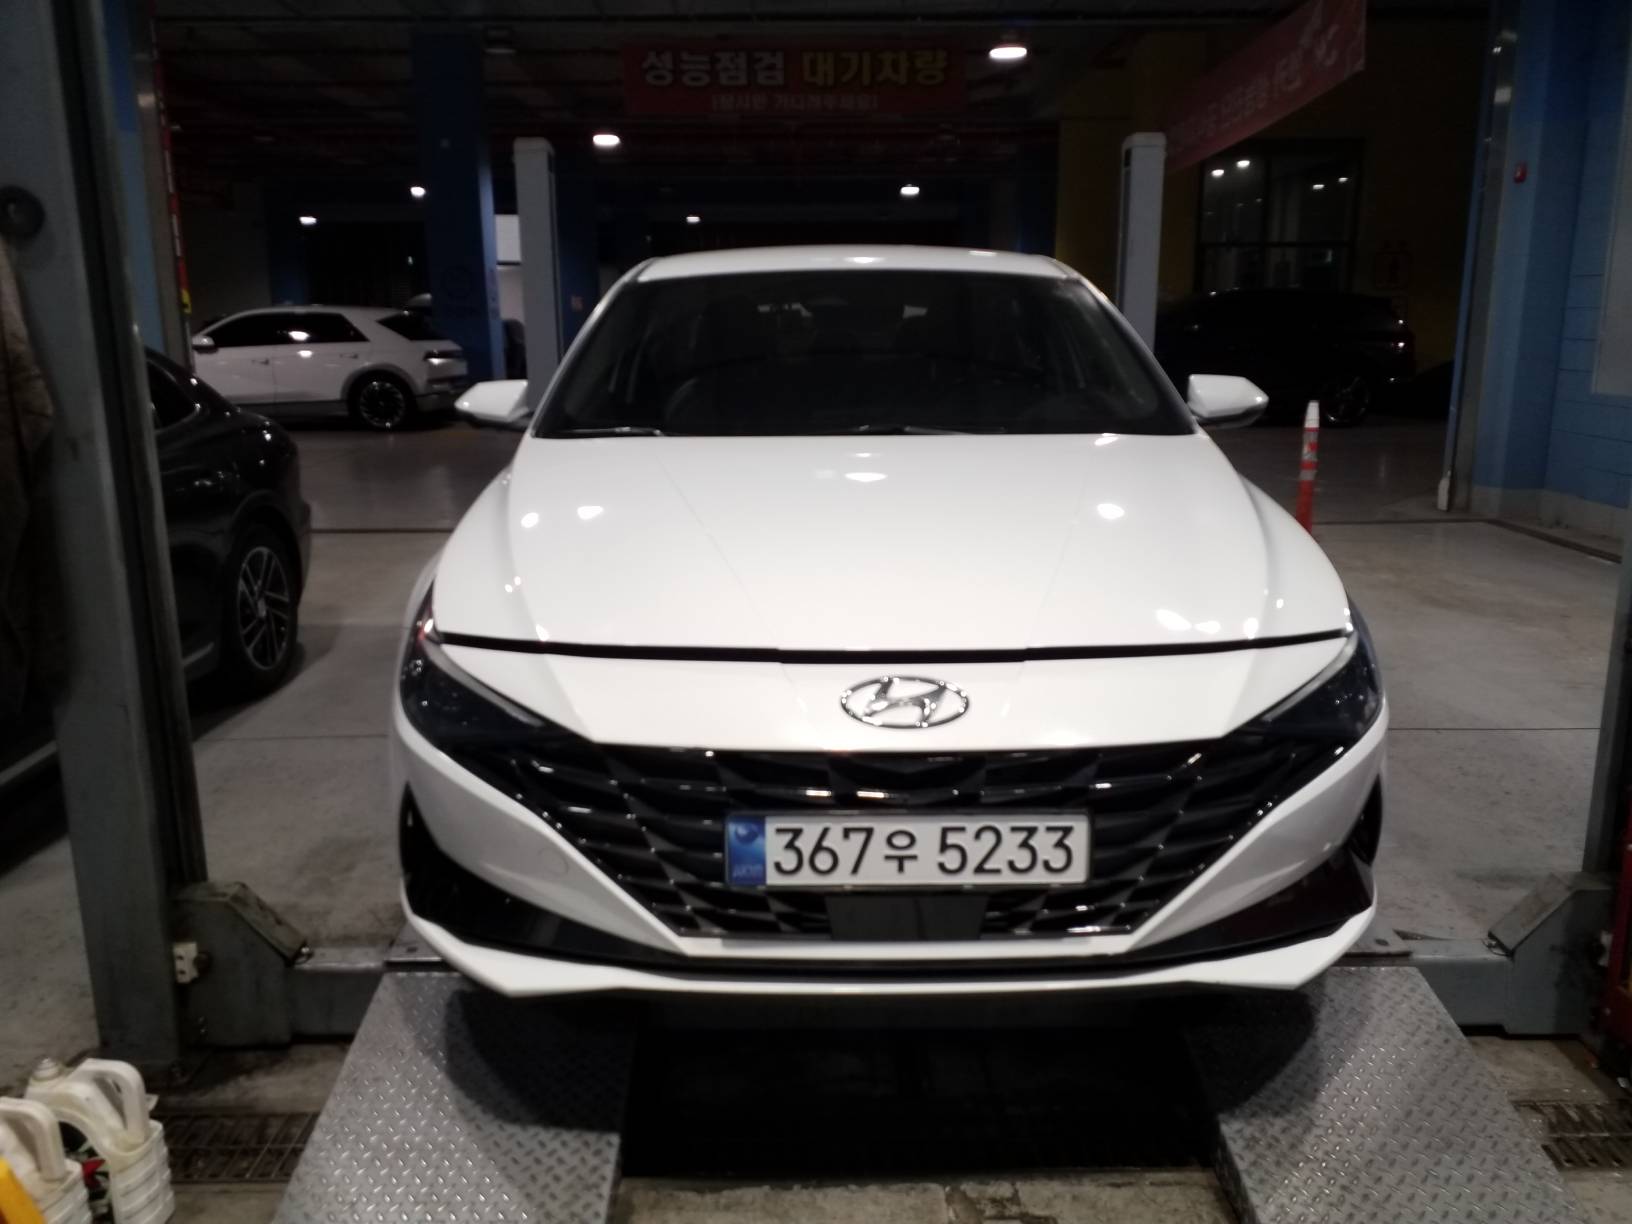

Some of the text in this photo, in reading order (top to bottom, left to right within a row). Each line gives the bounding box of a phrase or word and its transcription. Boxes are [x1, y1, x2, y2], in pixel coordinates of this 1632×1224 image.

[641, 49, 948, 87] 성능점검 대기차량
[773, 825, 1075, 875] 367우 5233
